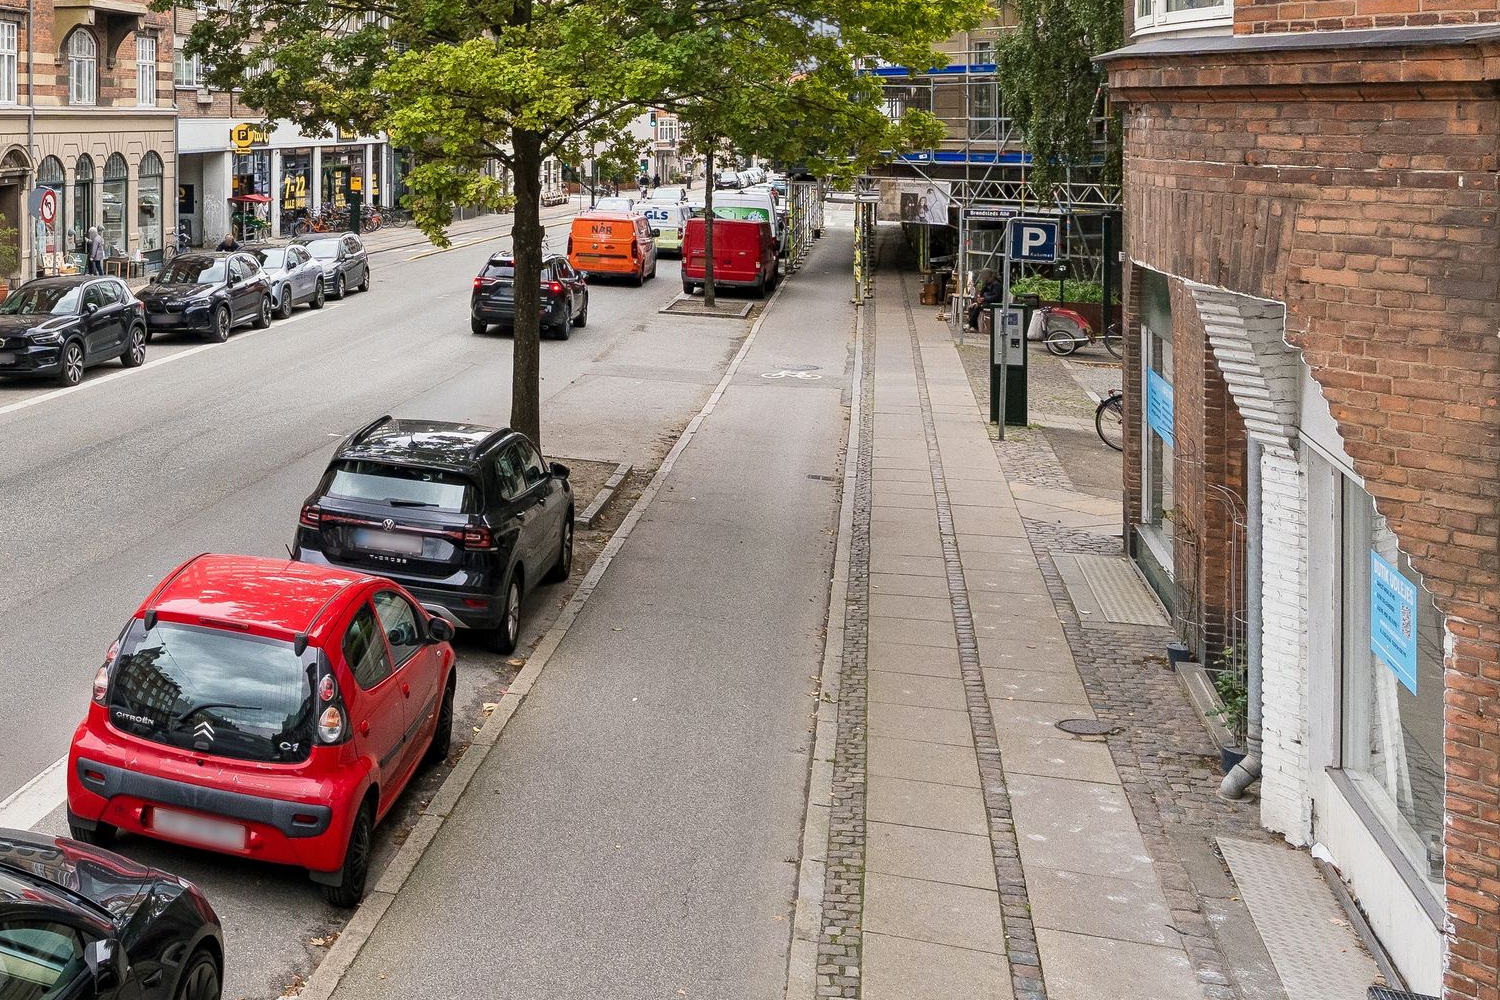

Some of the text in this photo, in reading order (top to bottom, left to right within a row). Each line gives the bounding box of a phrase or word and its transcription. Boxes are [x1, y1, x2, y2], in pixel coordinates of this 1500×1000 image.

[240, 131, 246, 139] P
[644, 211, 668, 219] GLS
[1022, 227, 1047, 256] P
[115, 711, 154, 725] CITROËN
[279, 741, 299, 752] C1
